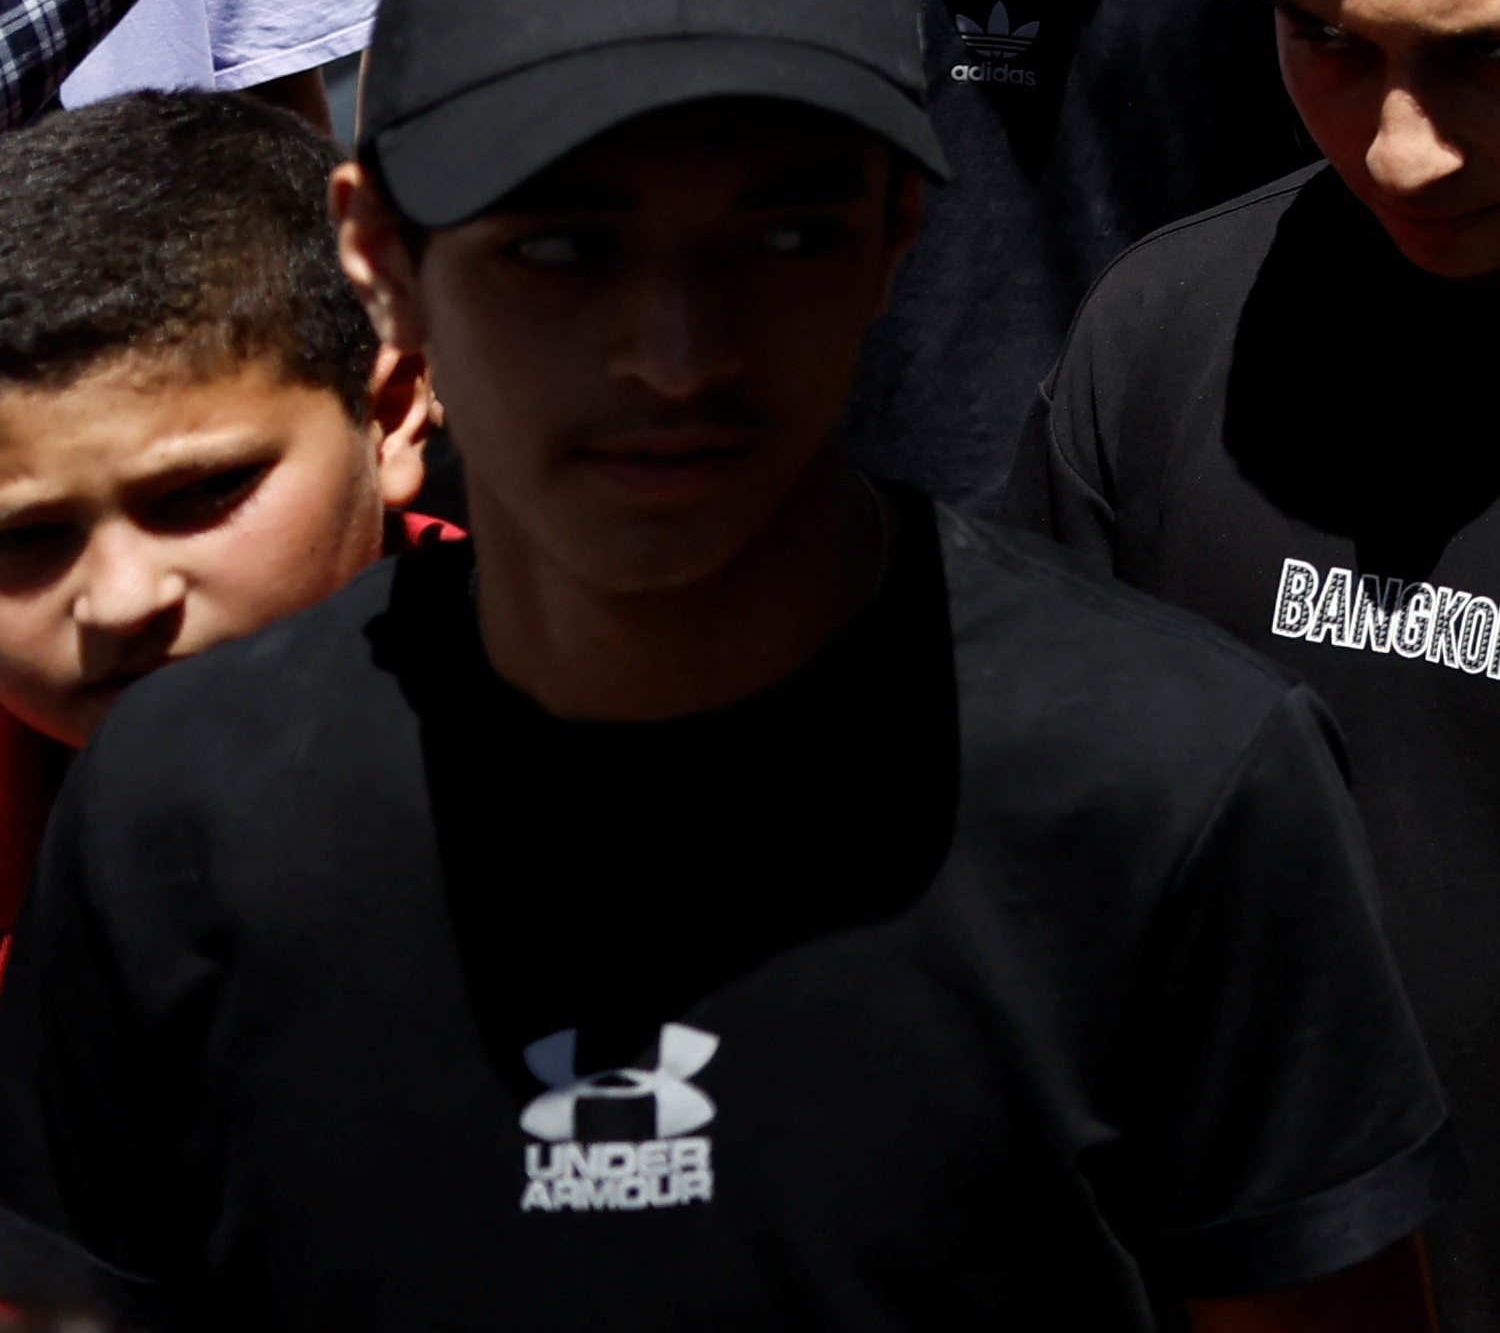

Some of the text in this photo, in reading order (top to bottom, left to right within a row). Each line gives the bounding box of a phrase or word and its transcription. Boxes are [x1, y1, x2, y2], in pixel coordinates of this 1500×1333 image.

[950, 60, 1037, 88] adidas
[524, 1136, 713, 1179] UNDER
[520, 1171, 714, 1212] ARMOUR
